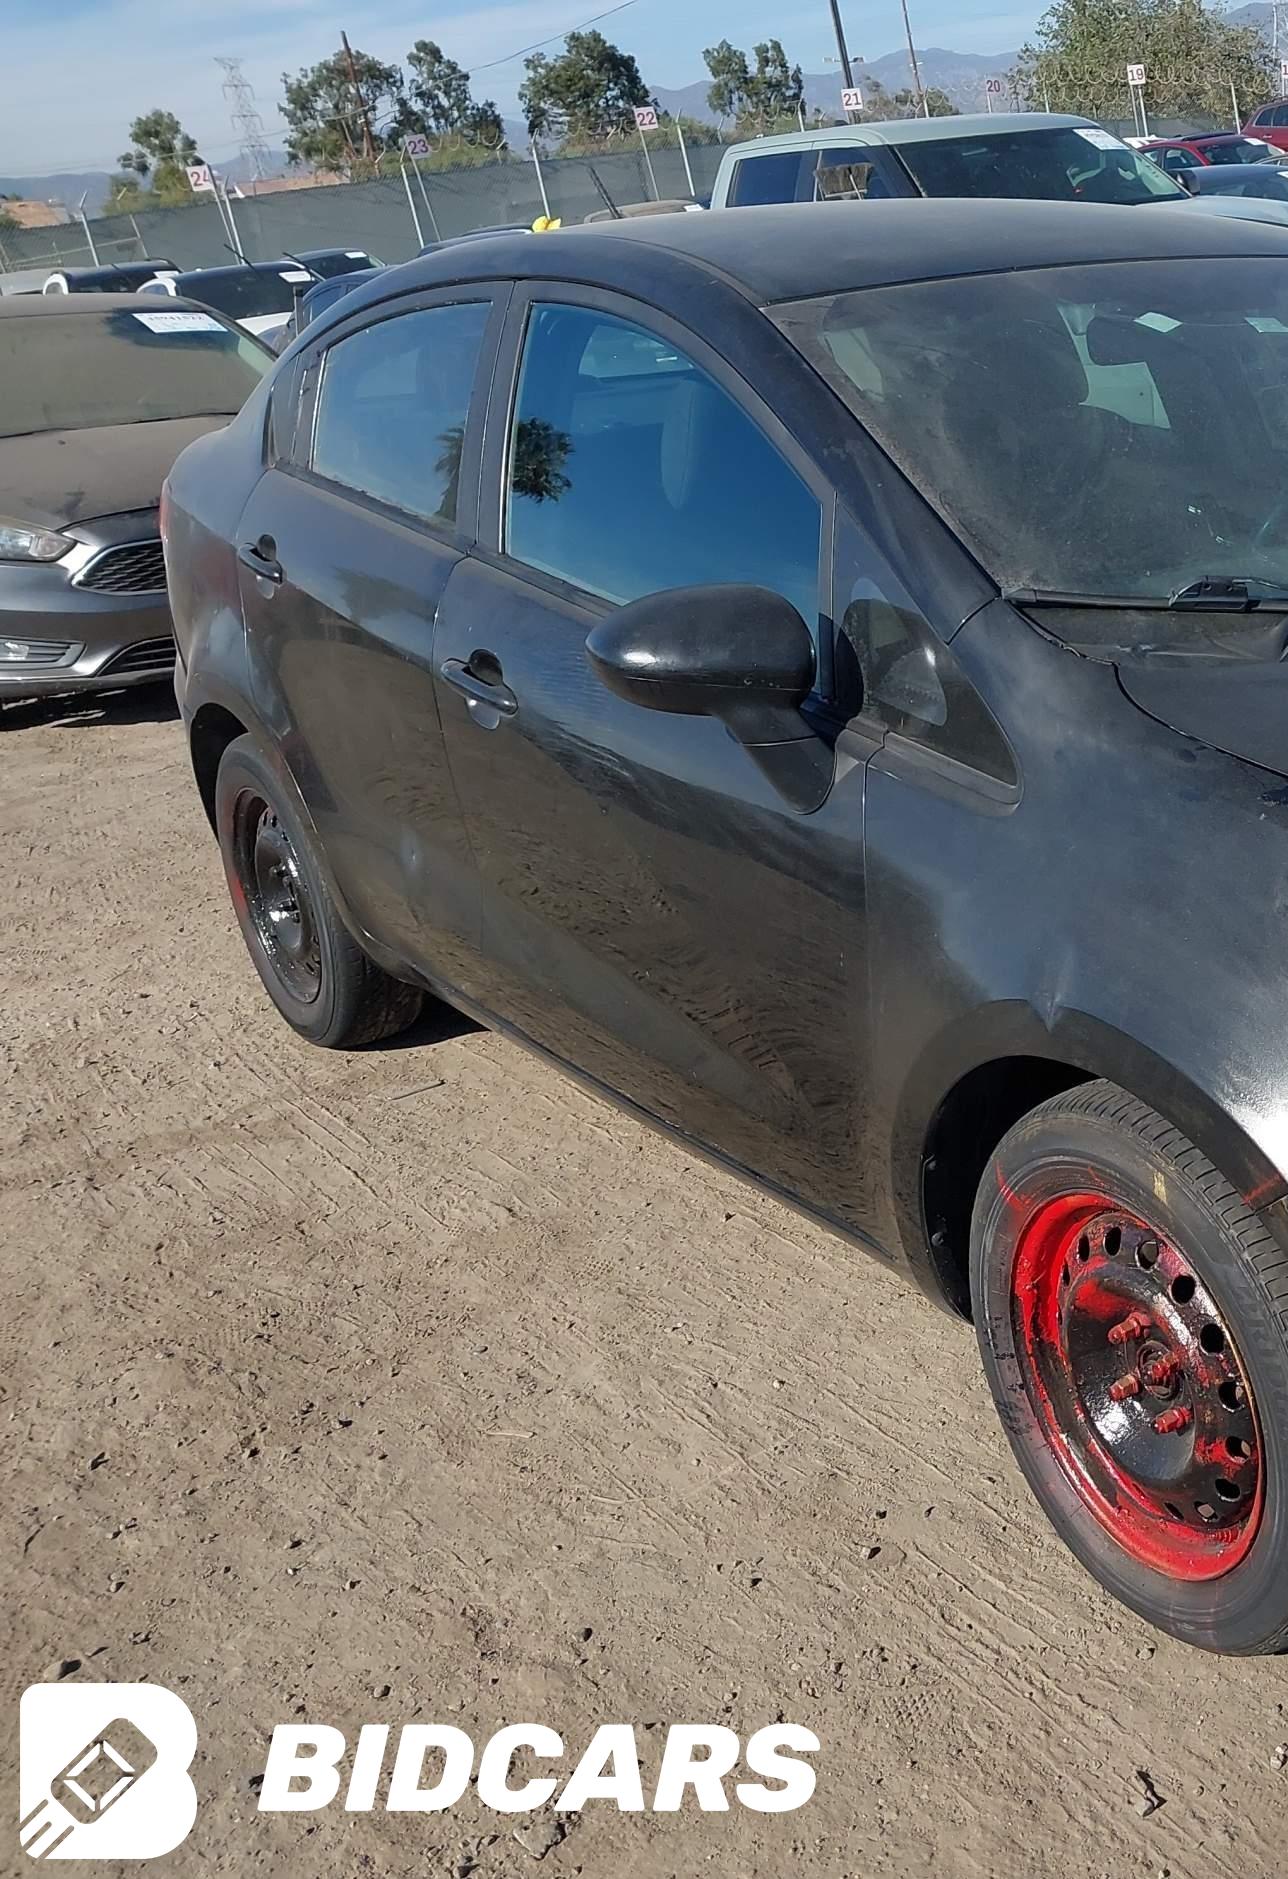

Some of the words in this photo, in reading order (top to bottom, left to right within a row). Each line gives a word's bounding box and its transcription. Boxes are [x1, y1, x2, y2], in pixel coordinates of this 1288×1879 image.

[1129, 68, 1144, 81] 19
[986, 79, 1001, 93] 20
[843, 92, 861, 107] 21
[636, 111, 657, 126] 22
[408, 138, 429, 155] 23
